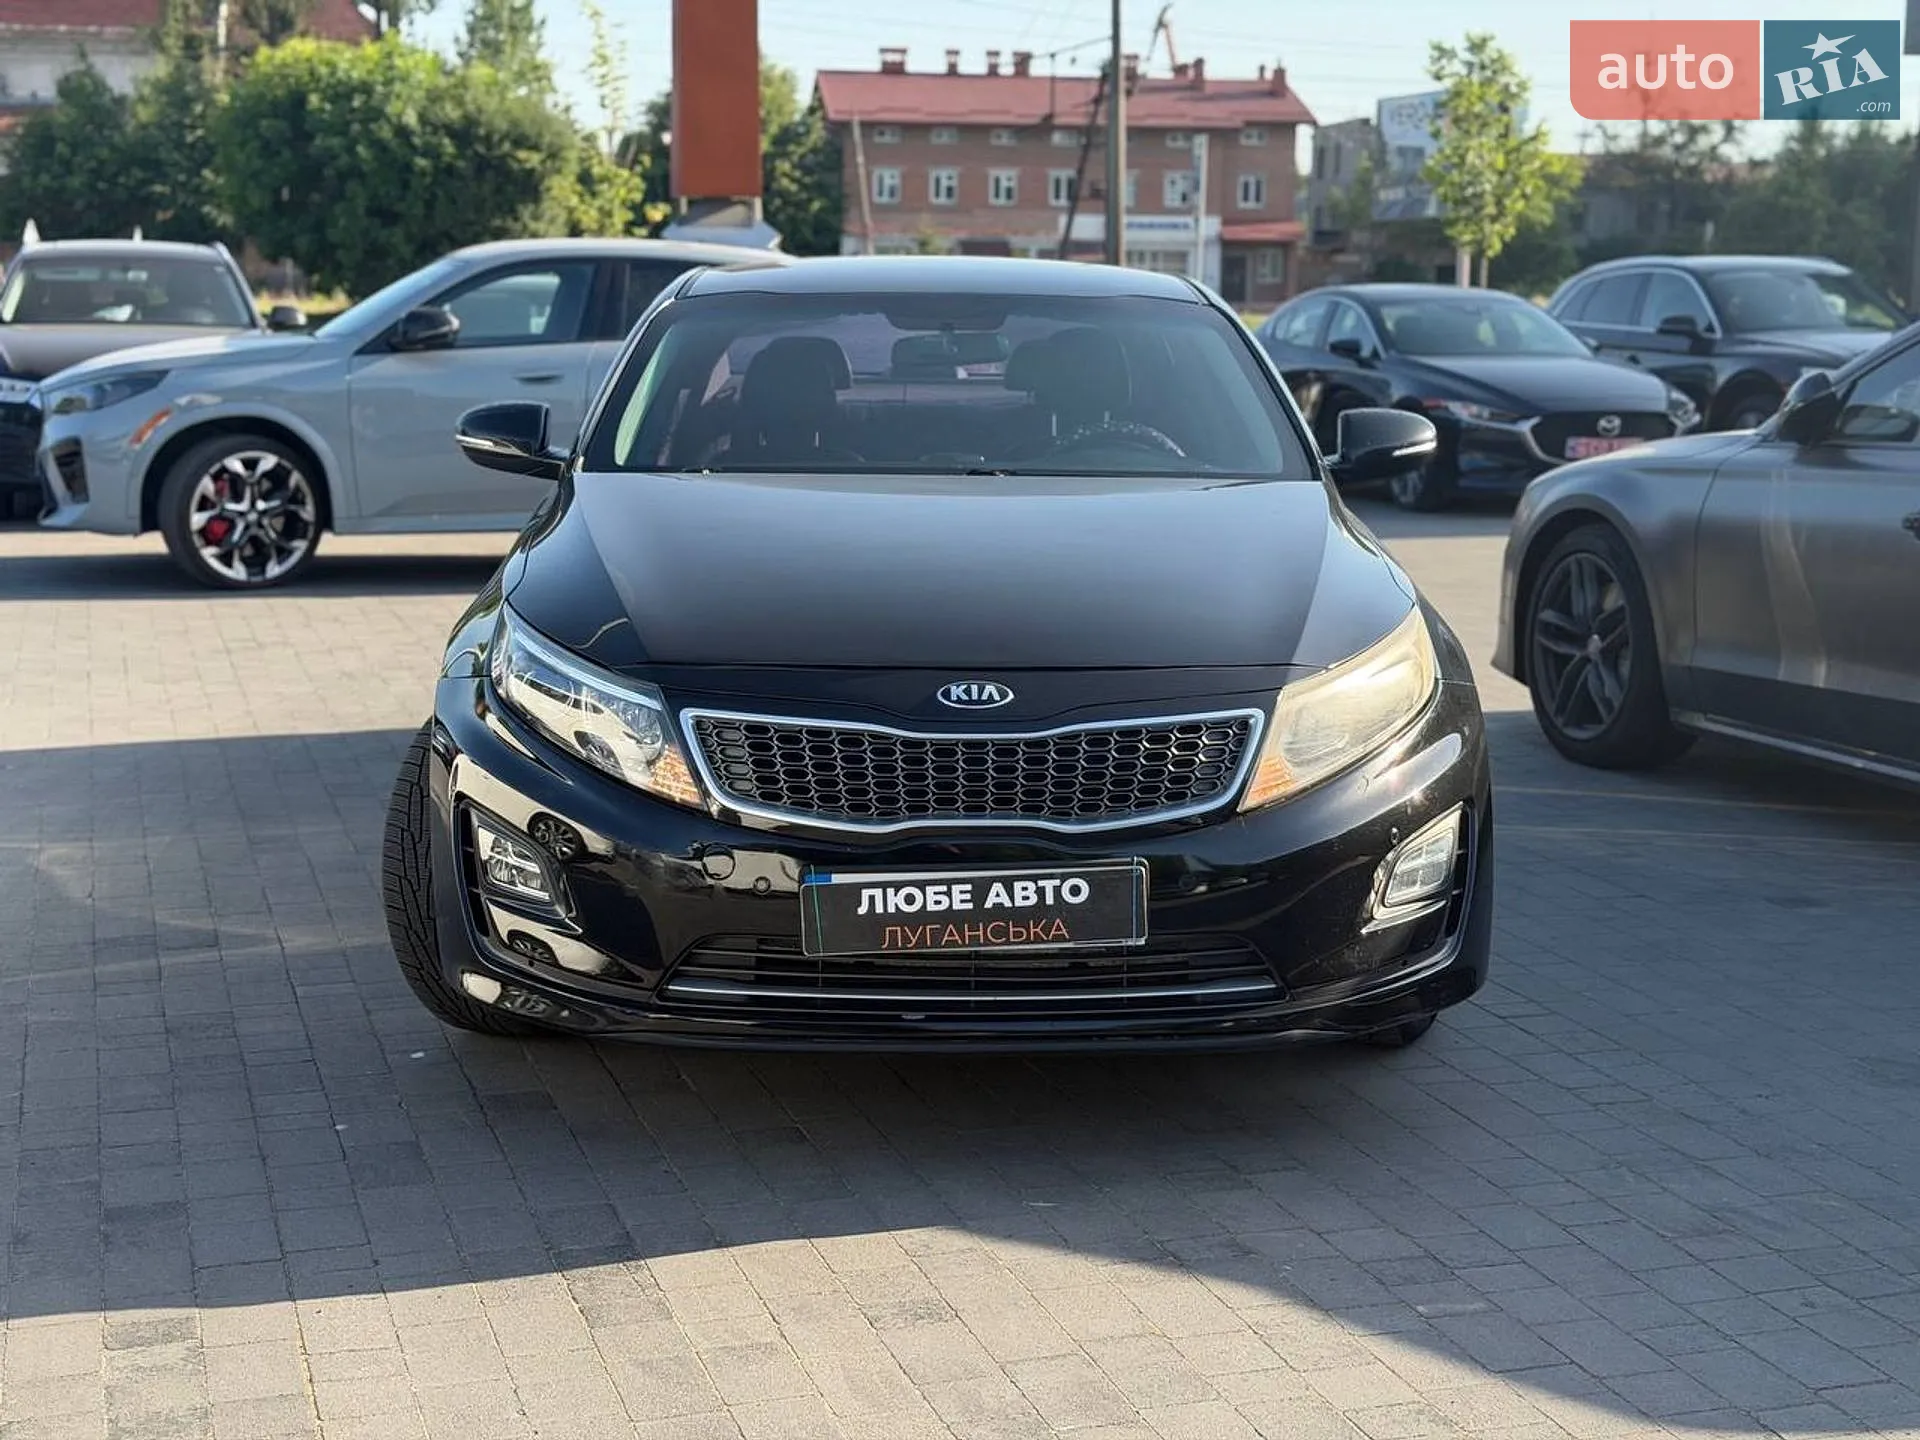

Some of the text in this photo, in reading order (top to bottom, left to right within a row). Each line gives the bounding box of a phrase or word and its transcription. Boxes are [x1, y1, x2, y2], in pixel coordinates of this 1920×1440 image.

[950, 684, 1001, 701] KIA
[857, 877, 1090, 915] ЛЮБЕ АВТО
[881, 918, 1070, 949] ЛУГАНСЬКА
